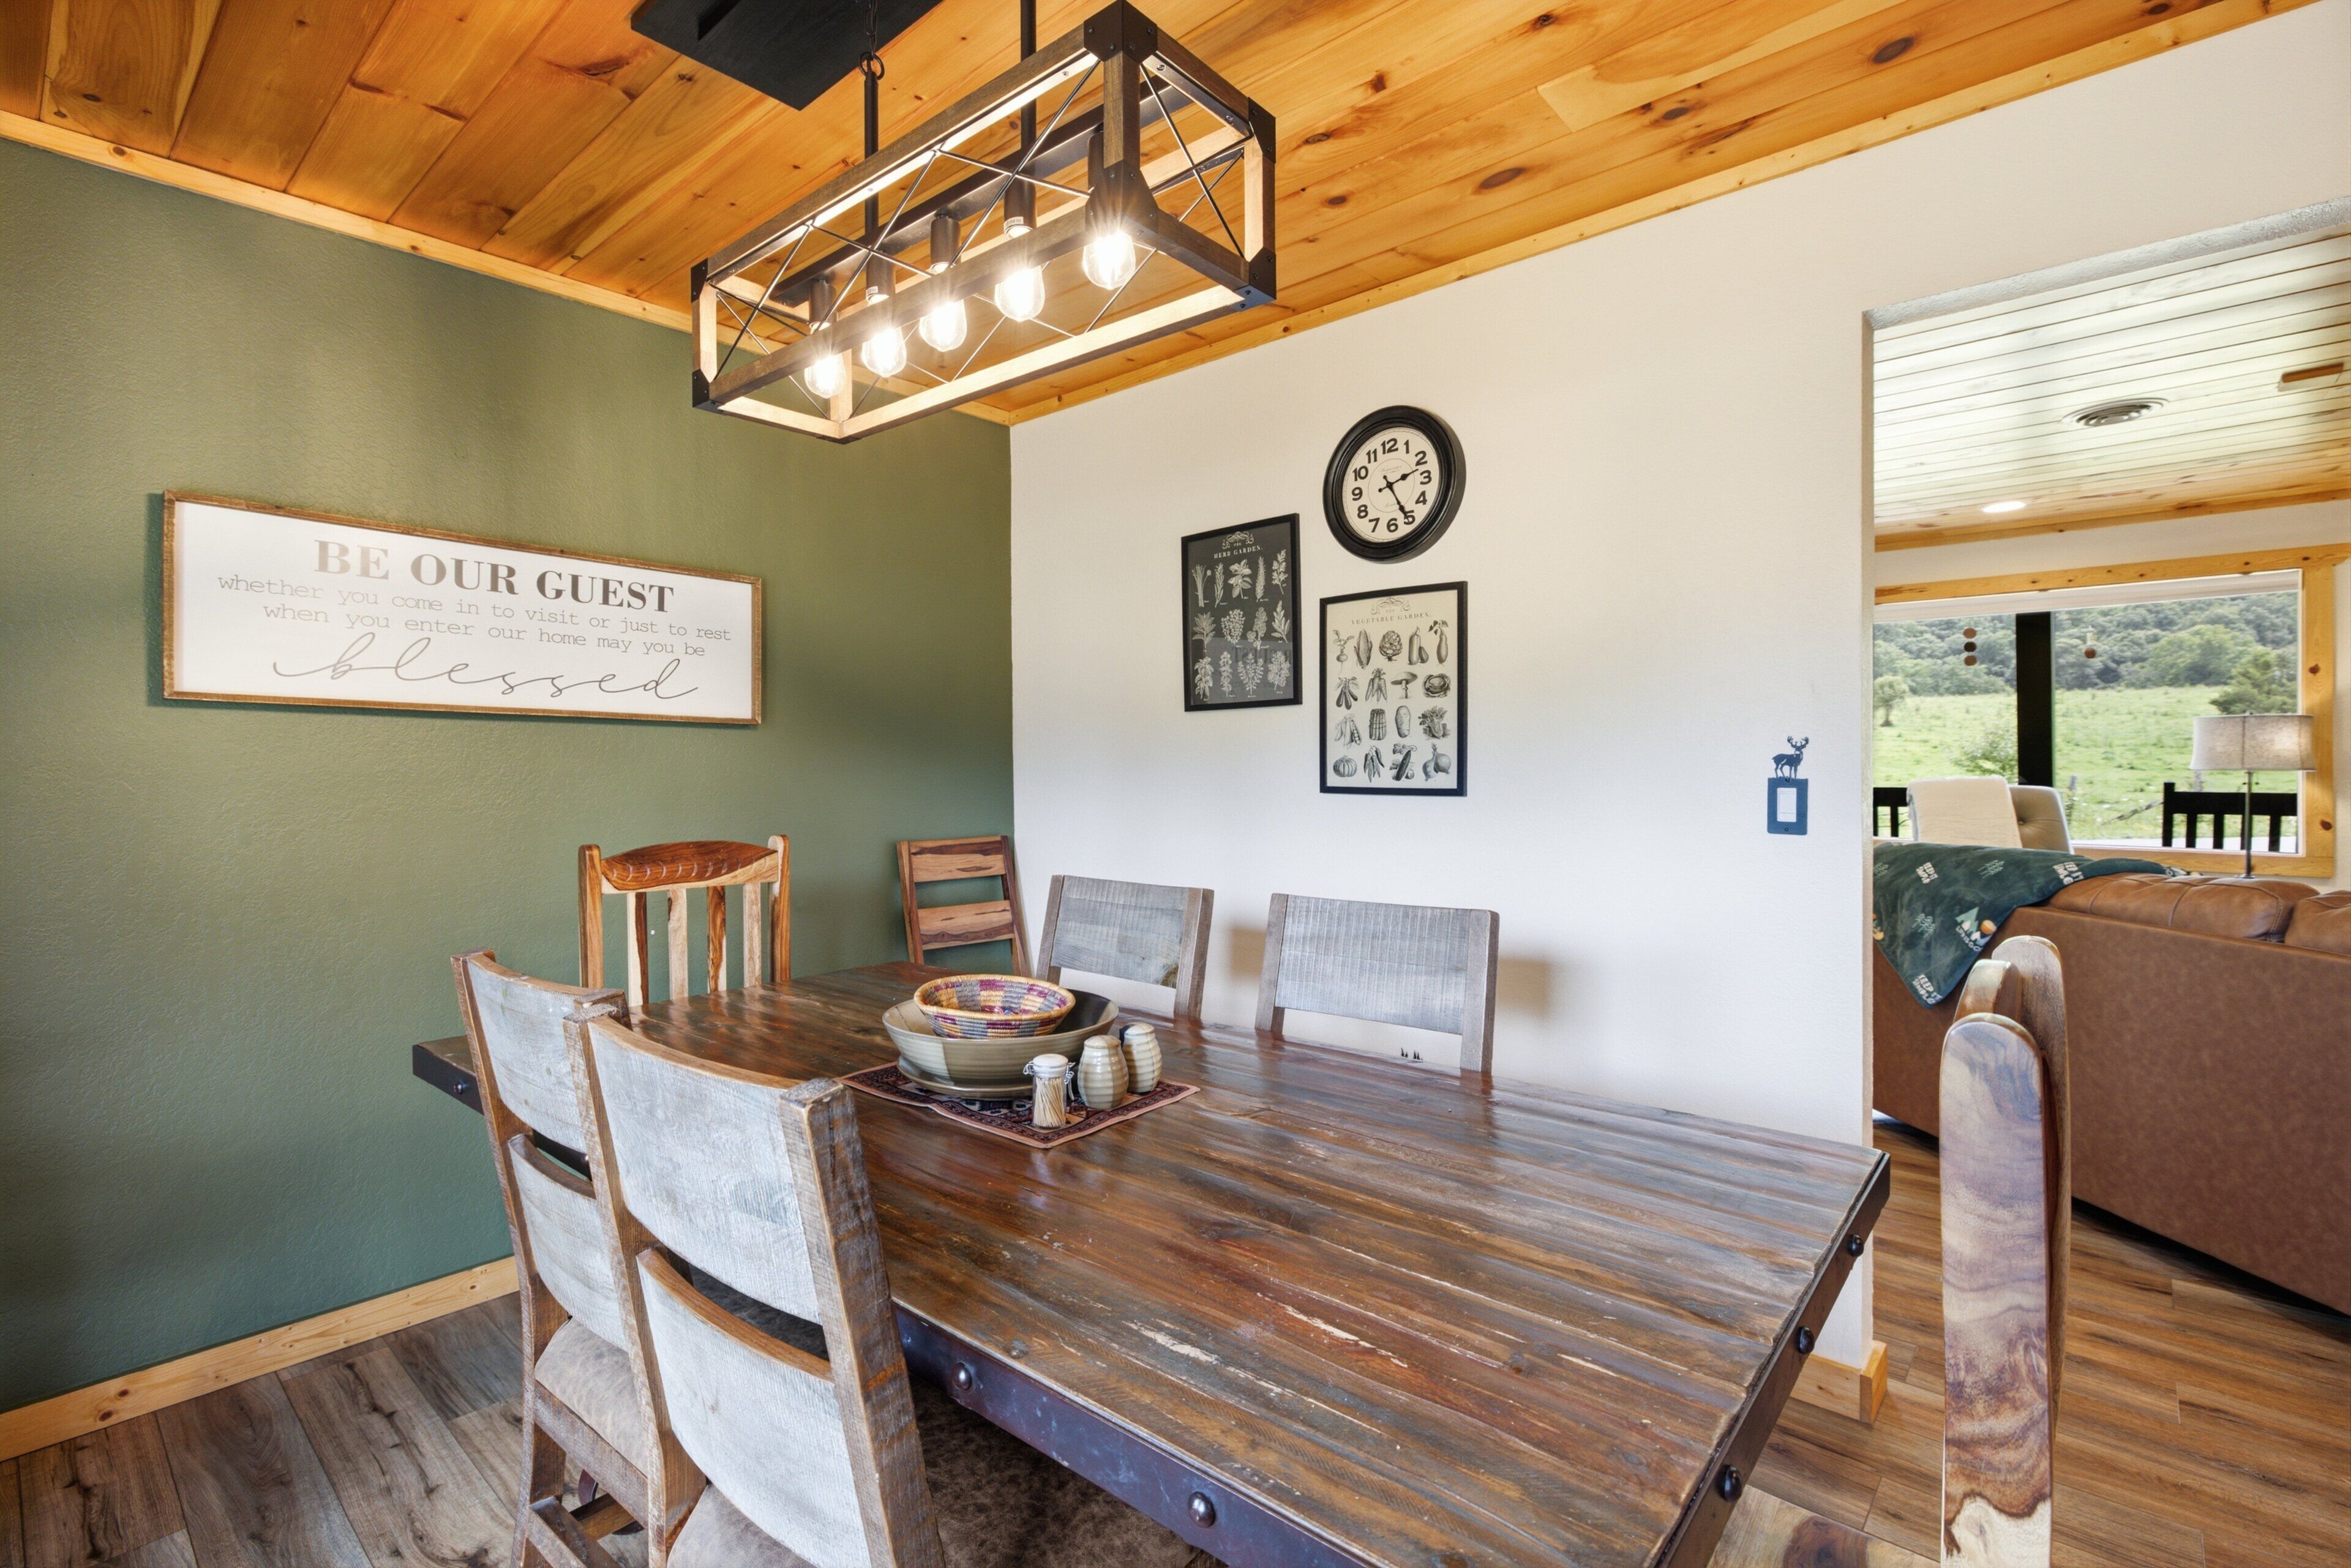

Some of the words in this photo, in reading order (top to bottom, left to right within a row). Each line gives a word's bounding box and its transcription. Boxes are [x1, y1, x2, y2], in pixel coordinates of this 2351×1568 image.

[1381, 438, 1398, 454] 12
[1404, 439, 1410, 454] 1
[1366, 448, 1378, 463] 11
[1415, 450, 1428, 467] 2
[1352, 465, 1368, 481] 10
[1420, 470, 1432, 485] 3
[1352, 487, 1363, 501] 9
[1415, 490, 1428, 505] 4
[1357, 505, 1368, 519] 8
[1403, 510, 1415, 525] 5
[1368, 517, 1380, 533] 7
[1387, 517, 1398, 533] 6
[314, 540, 389, 580] BE
[411, 554, 519, 595] OUR
[536, 571, 674, 613] GUEST
[218, 574, 323, 598] whether
[338, 591, 378, 606] you
[392, 596, 443, 610] come
[456, 599, 479, 615] in
[492, 604, 514, 618] to
[525, 608, 579, 625] visit
[589, 617, 610, 628] or
[620, 617, 658, 633] just
[669, 623, 687, 636] to
[696, 628, 731, 640] rest
[263, 603, 329, 622] when
[346, 614, 390, 629] you
[405, 620, 474, 635] enter
[488, 628, 527, 640] our
[539, 628, 586, 645] home
[597, 638, 632, 653] may
[643, 642, 674, 655] you
[684, 642, 705, 656] be
[273, 629, 699, 699] blessed
